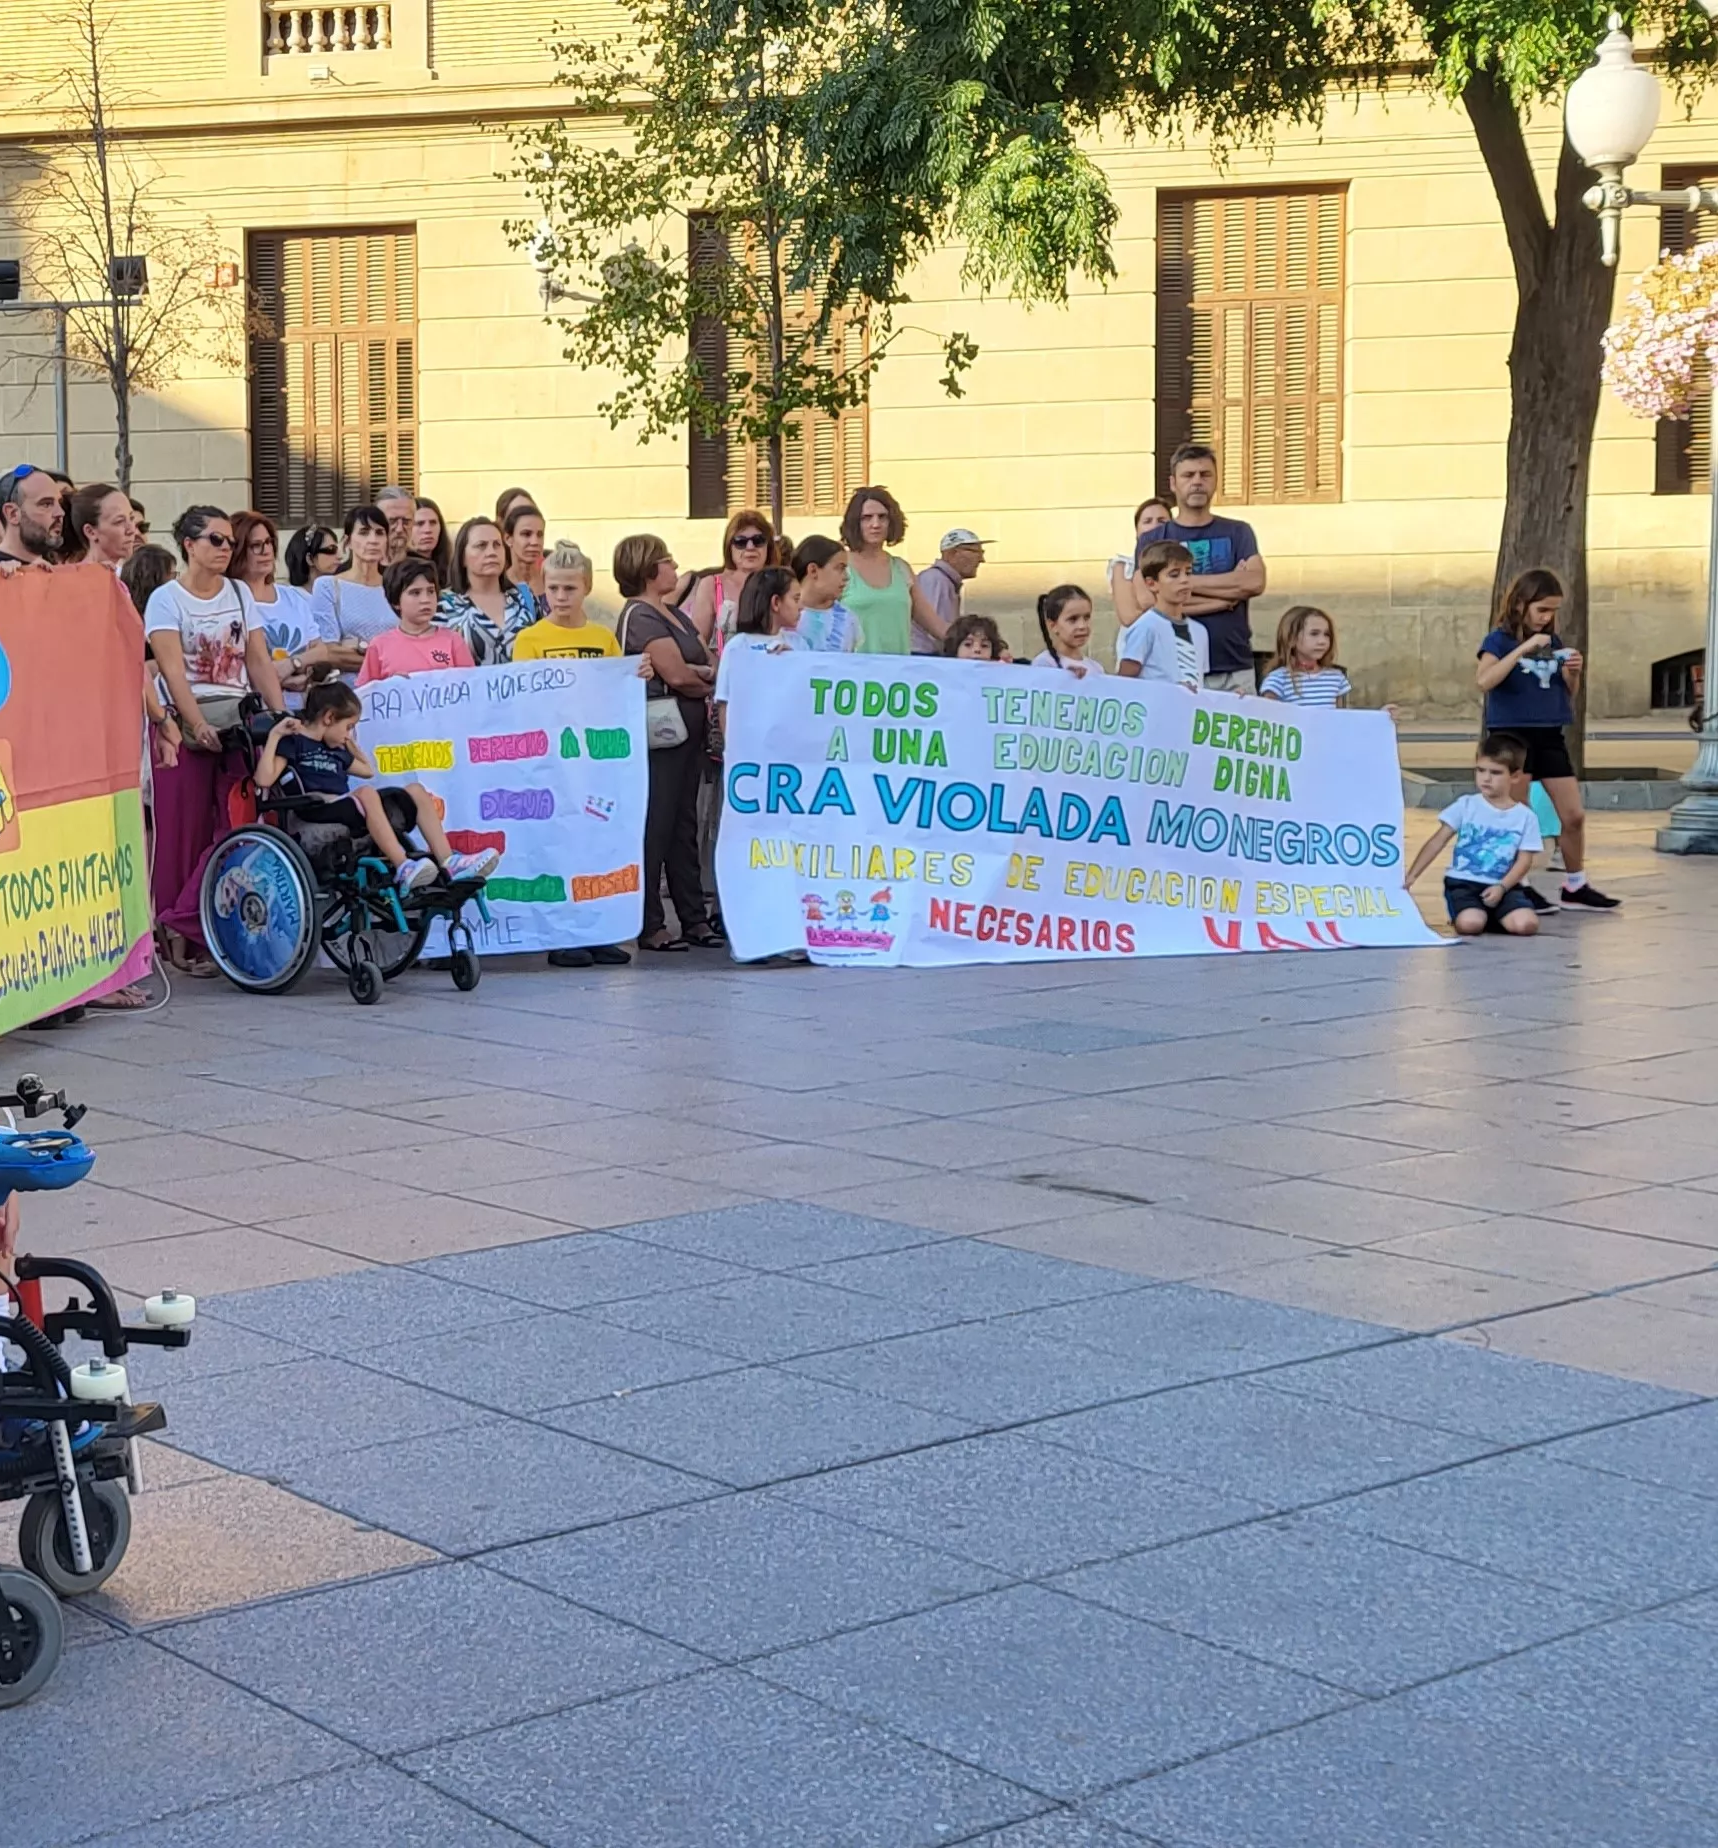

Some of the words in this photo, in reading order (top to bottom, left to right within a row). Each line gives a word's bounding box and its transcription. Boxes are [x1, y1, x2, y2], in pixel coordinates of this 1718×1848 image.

[468, 730, 548, 763] DERECHO
[810, 678, 939, 719] TODOS
[982, 687, 1148, 738] TENEMOS
[1192, 709, 1302, 761] DERECHO
[826, 727, 849, 762] A
[873, 728, 948, 768] UNA
[994, 733, 1189, 787] EDUCACION
[1214, 756, 1292, 802] DIGNA
[728, 762, 856, 816] CRA
[873, 773, 1131, 846] VIOLADA
[1147, 800, 1400, 868] MONEGROS
[270, 858, 300, 926] MARTINA
[749, 838, 975, 887] AUXILIARES
[1006, 853, 1044, 891] DE
[1065, 861, 1243, 914] EDUCACION
[1255, 881, 1403, 918] ESPECIAL
[929, 897, 1137, 954] NECESARIOS
